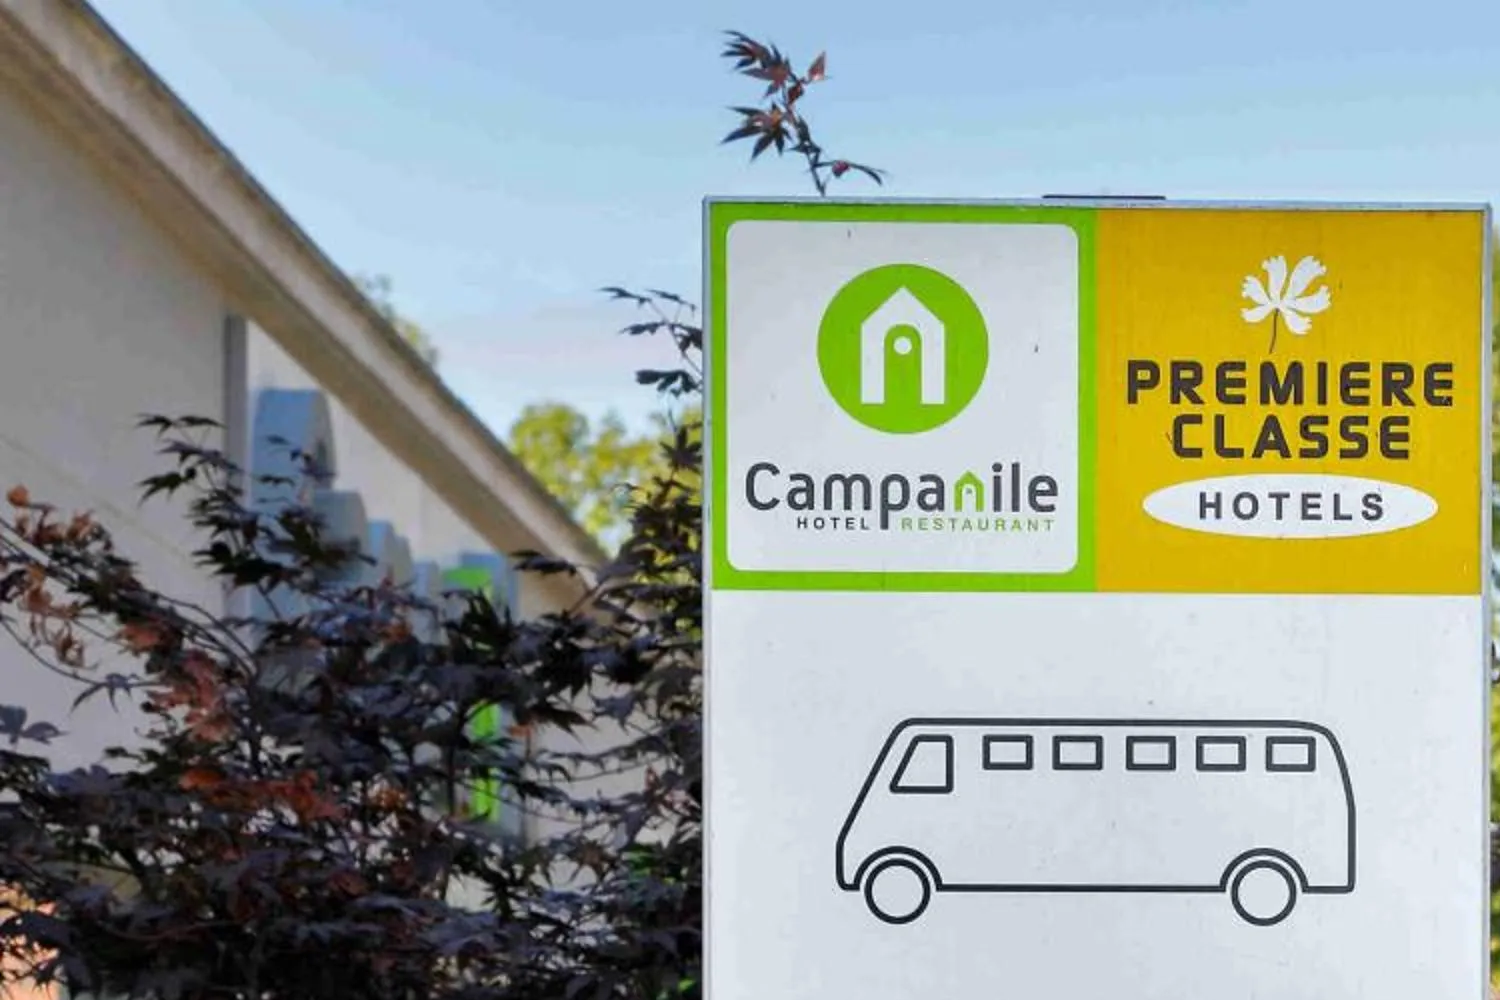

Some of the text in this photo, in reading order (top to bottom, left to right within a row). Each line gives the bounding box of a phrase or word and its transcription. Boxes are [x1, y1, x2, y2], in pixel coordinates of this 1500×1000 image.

[1126, 360, 1454, 407] PREMIERE
[1171, 413, 1410, 460] CLASSE
[745, 462, 1059, 530] Campanile
[1198, 491, 1385, 521] HOTELS
[796, 517, 1055, 532] HOTEL RESTAURANT
